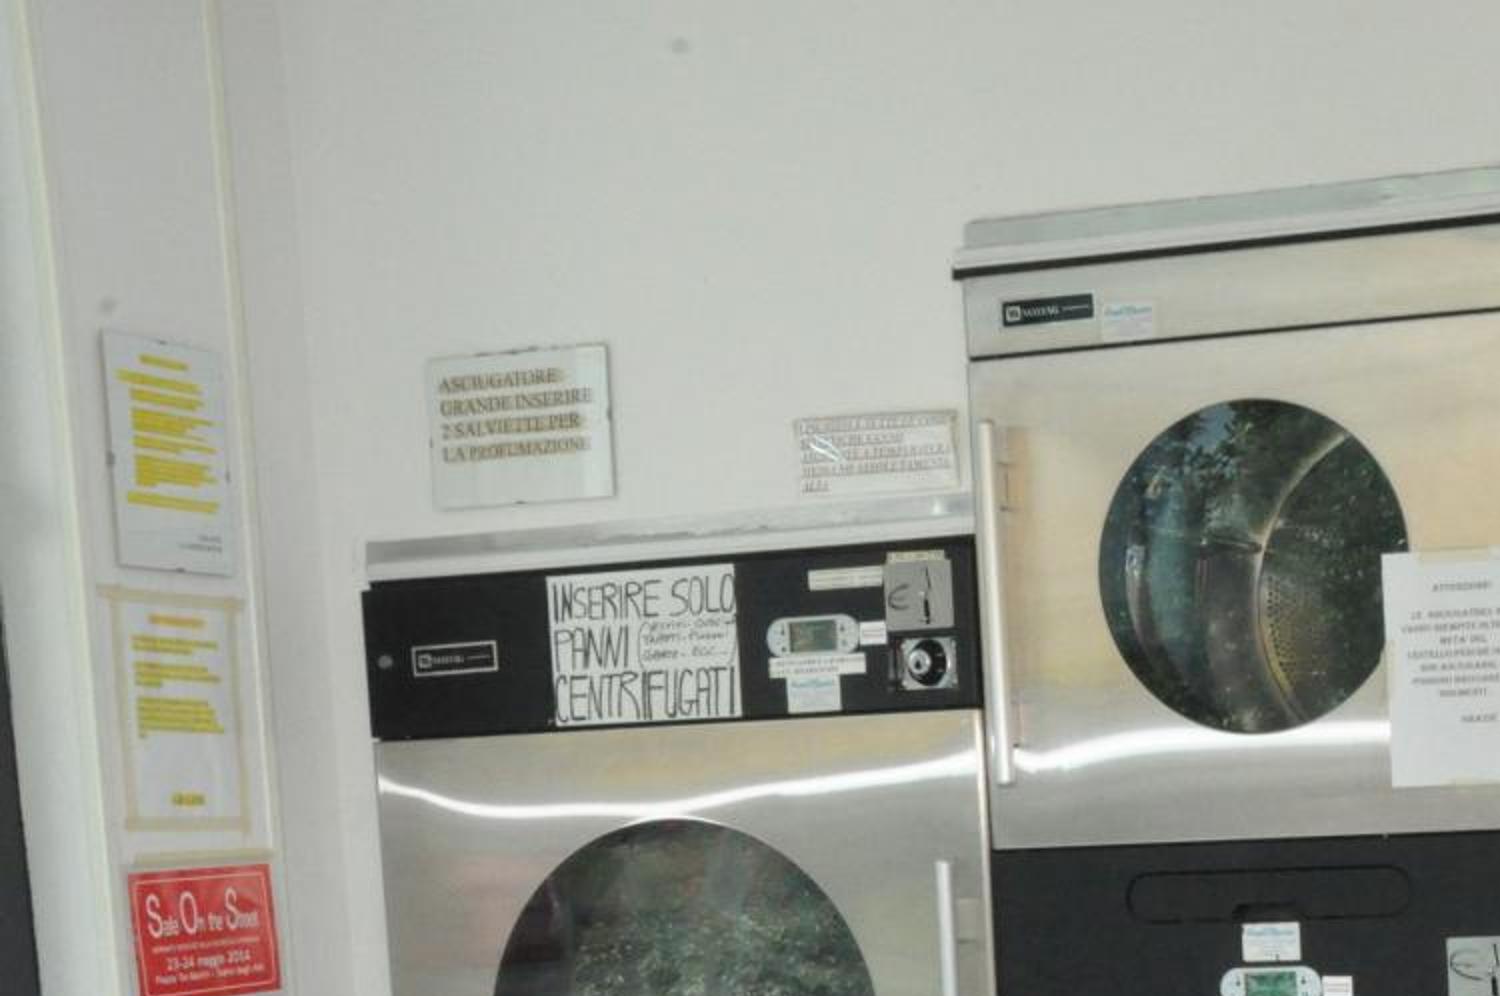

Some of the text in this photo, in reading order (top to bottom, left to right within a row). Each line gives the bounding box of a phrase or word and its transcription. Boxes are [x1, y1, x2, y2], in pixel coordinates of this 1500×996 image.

[552, 572, 736, 623] INSERIRE SOLO
[553, 625, 629, 672] PANNI
[556, 666, 736, 722] CENTRIFUGATI
